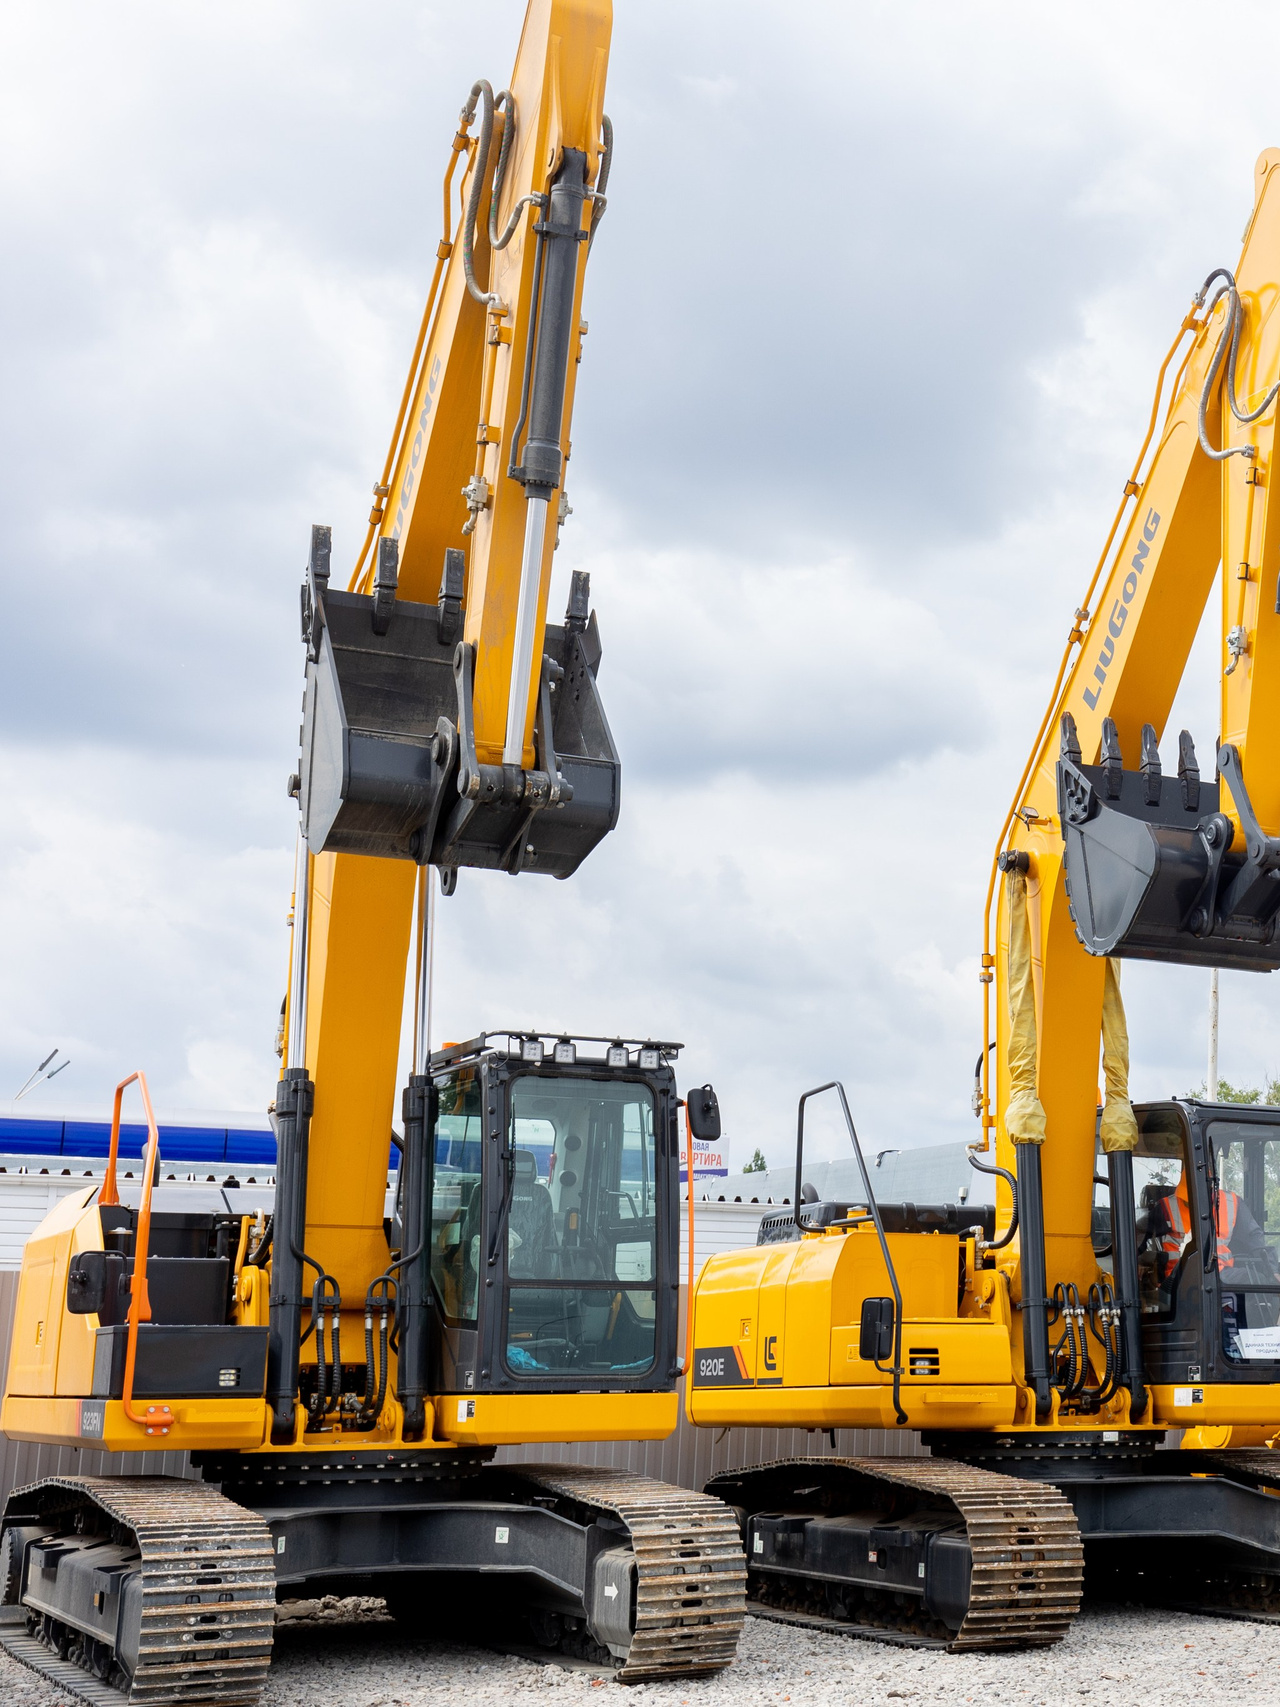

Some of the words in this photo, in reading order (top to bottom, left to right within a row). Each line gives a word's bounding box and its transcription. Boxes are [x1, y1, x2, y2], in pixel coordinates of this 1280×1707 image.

[393, 353, 441, 541] UGONG
[1082, 507, 1161, 711] LIUGONG
[692, 1141, 710, 1151] ОВАЯ
[700, 1358, 725, 1377] 920E
